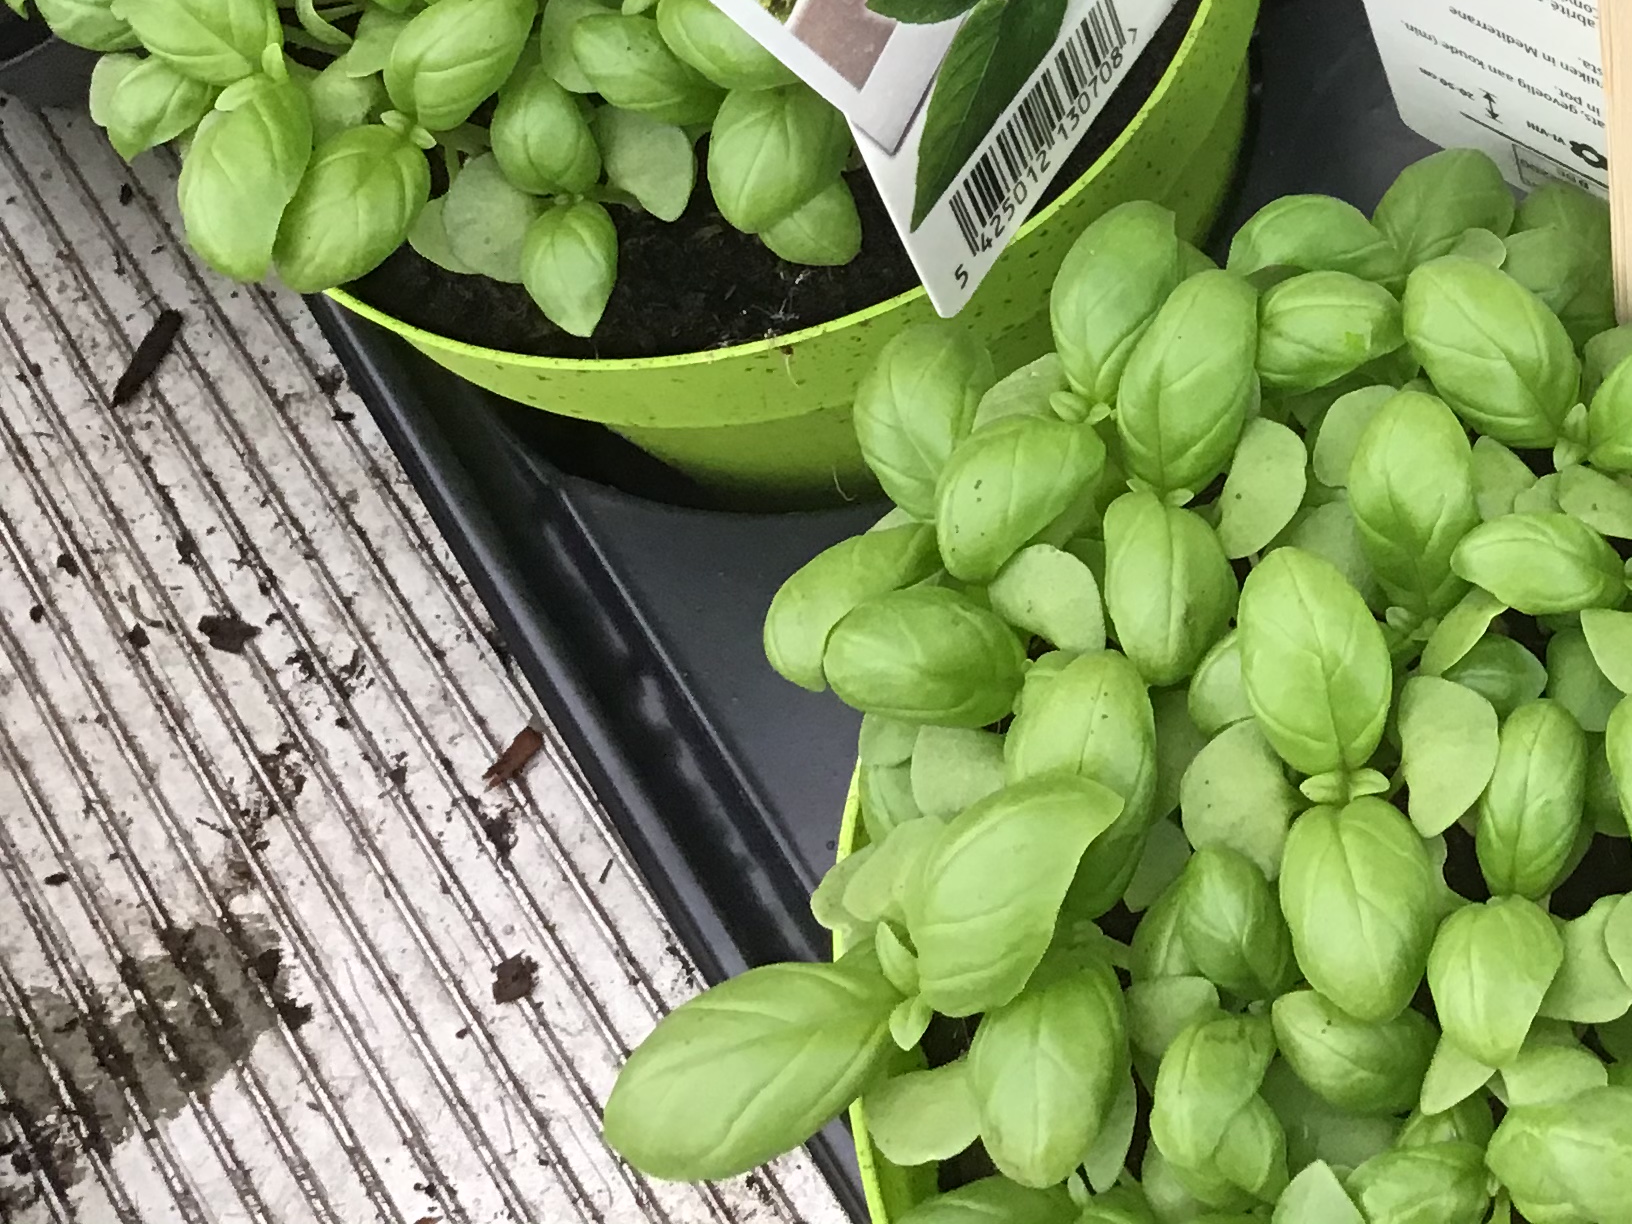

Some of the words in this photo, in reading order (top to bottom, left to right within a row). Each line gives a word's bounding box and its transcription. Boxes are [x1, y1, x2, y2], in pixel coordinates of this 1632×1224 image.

[1449, 6, 1537, 57] Mediterrane
[1441, 41, 1485, 69] koude
[1542, 52, 1555, 66] in
[1487, 64, 1513, 81] aan
[1517, 78, 1577, 114] gevoelig
[1586, 103, 1600, 116] in
[954, 263, 969, 290] 5
[979, 148, 1052, 254] 425012
[1057, 46, 1124, 141] 130708
